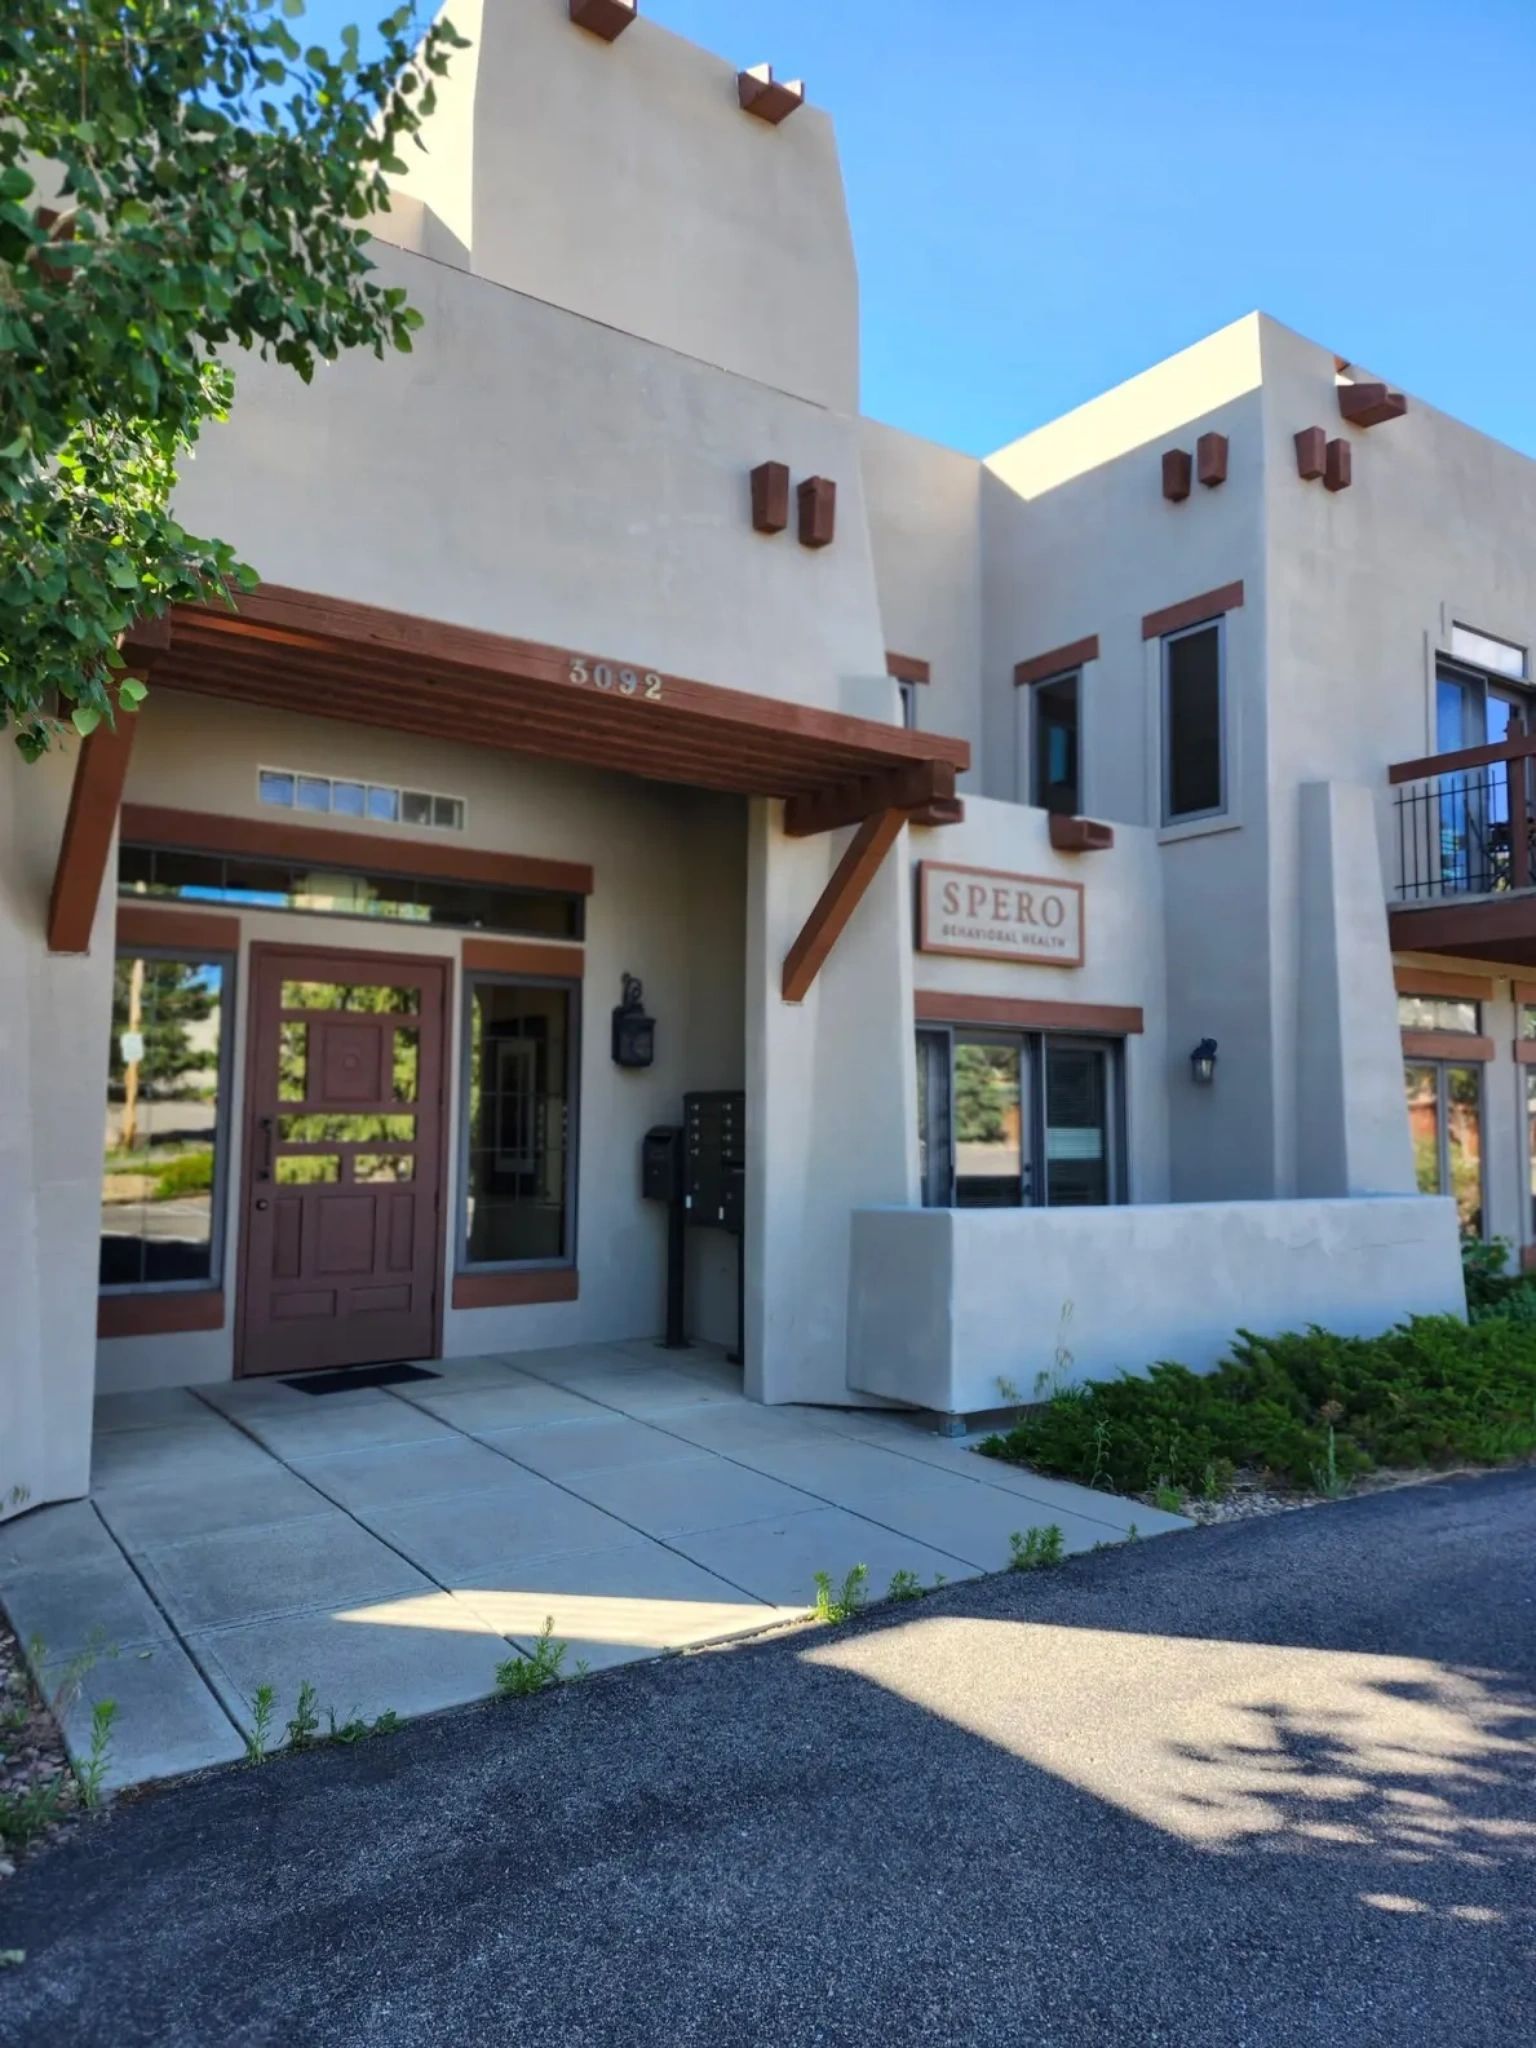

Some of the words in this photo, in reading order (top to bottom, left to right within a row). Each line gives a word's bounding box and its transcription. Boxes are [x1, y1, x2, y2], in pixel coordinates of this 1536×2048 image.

[569, 658, 662, 700] 3092
[942, 881, 1065, 928] SPERO
[942, 924, 1018, 944] BEHAVIORAL
[1022, 931, 1065, 948] HEALTH
